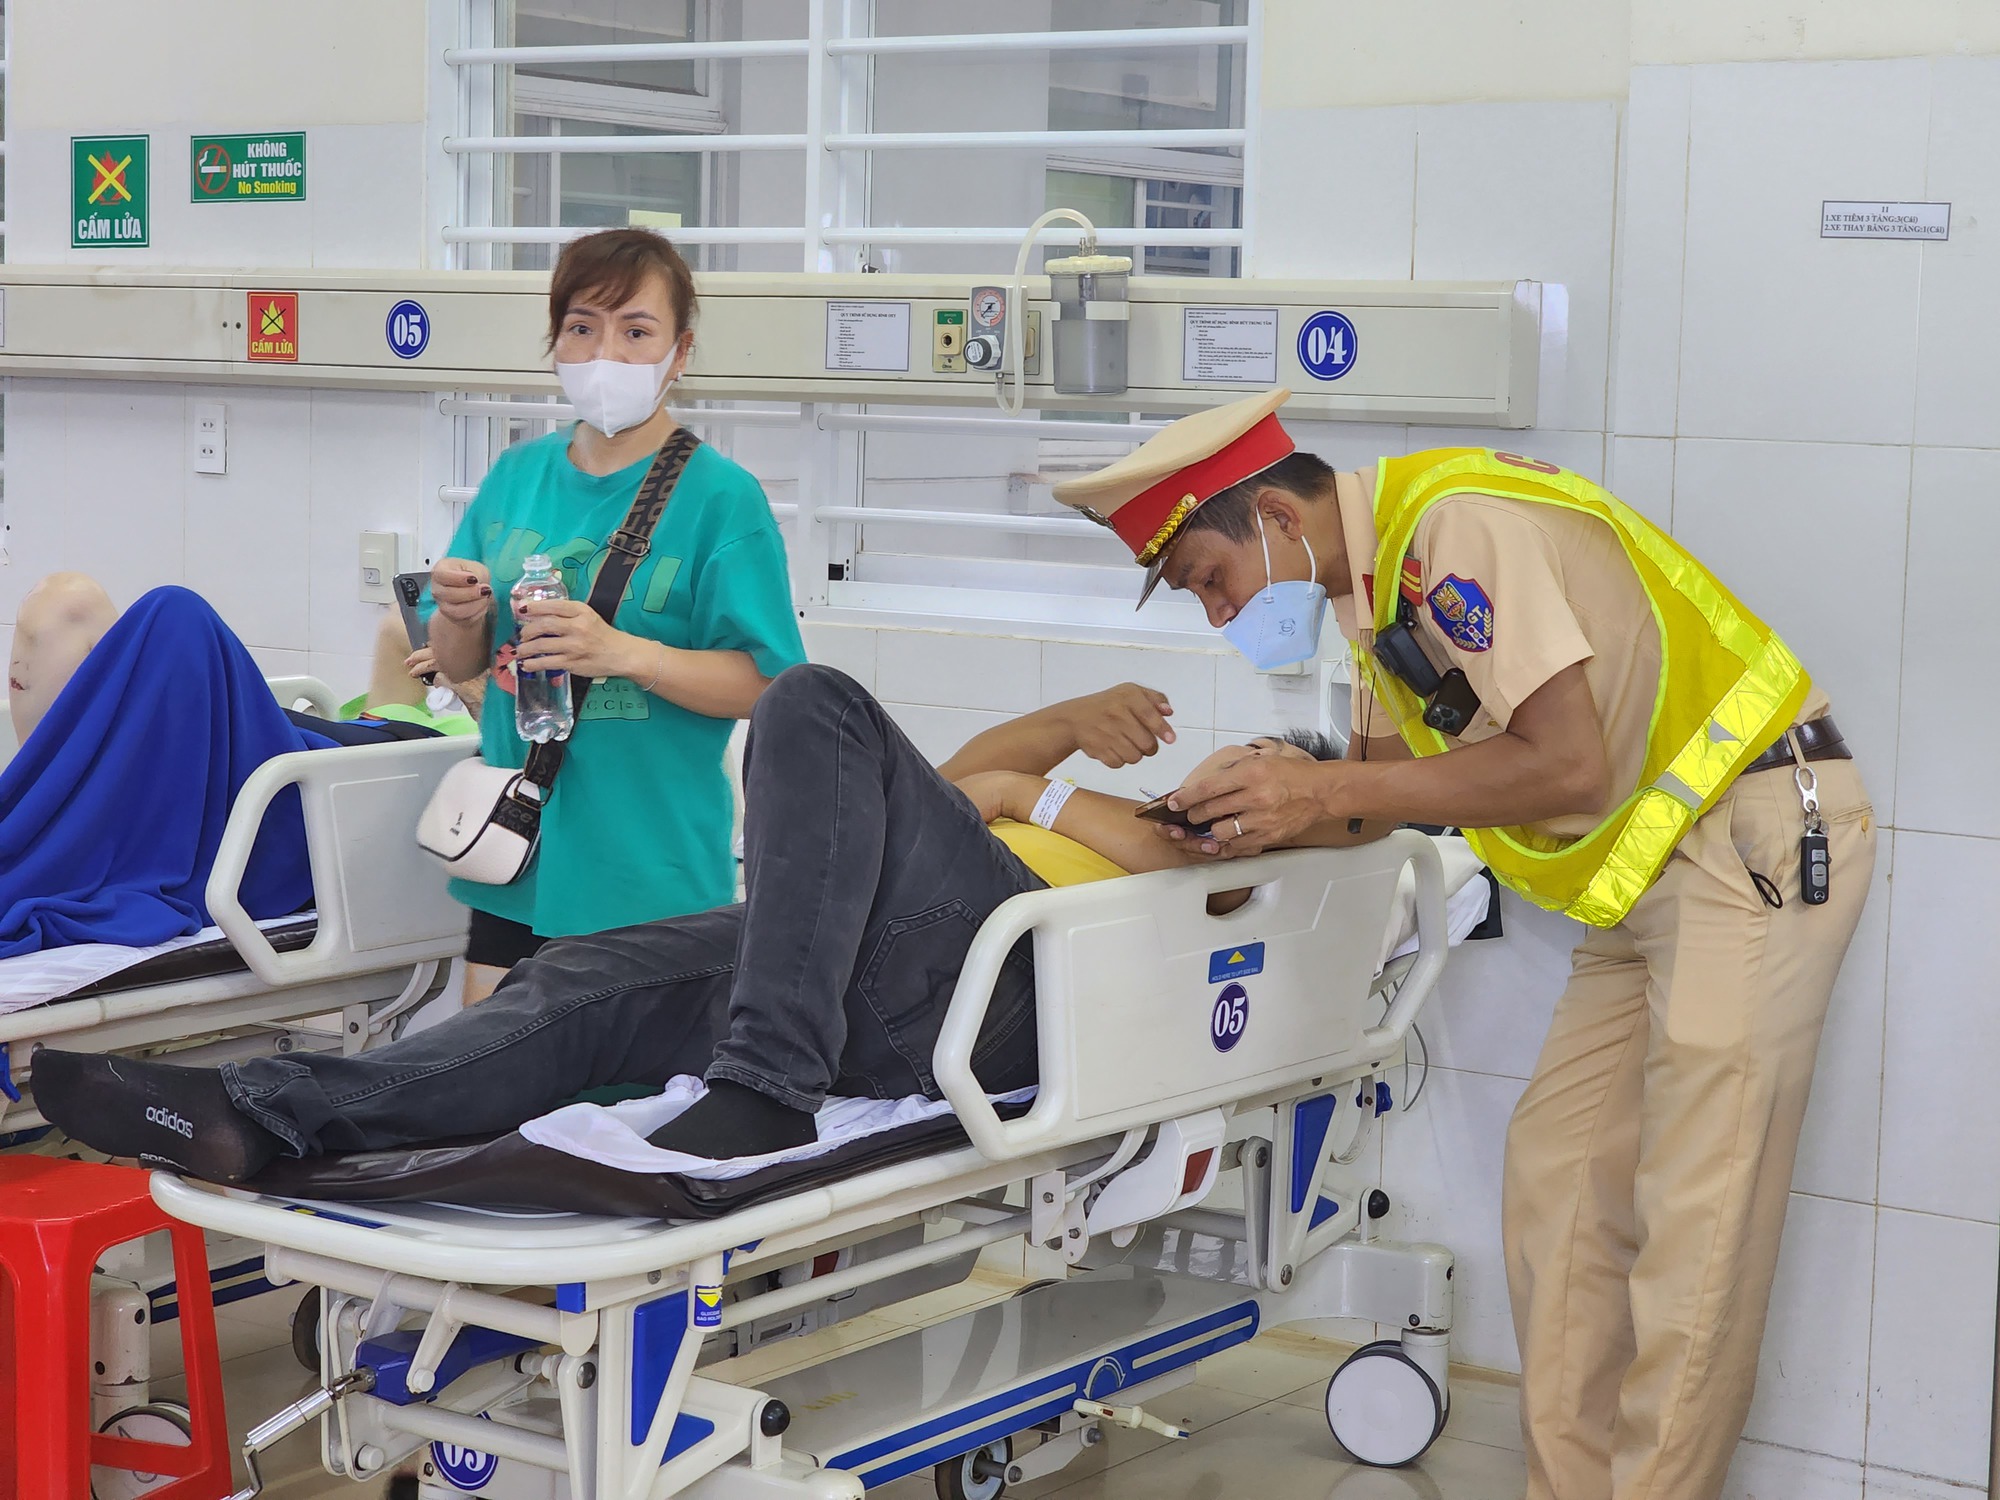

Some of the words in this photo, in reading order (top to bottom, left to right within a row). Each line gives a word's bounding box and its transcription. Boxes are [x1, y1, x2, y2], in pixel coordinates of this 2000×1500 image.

[247, 140, 287, 158] KHÔNG
[232, 160, 257, 178] HÚT
[260, 158, 302, 177] THUỐC
[238, 181, 252, 194] No
[254, 180, 297, 194] Smoking
[78, 211, 111, 239] CẤM
[114, 211, 142, 239] LỬA
[393, 313, 422, 347] 05
[252, 338, 273, 354] CẤM
[275, 338, 294, 354] LỬA
[1307, 326, 1347, 365] 04
[1466, 605, 1483, 624] GT
[1214, 996, 1246, 1037] 05
[145, 1106, 194, 1139] adidas
